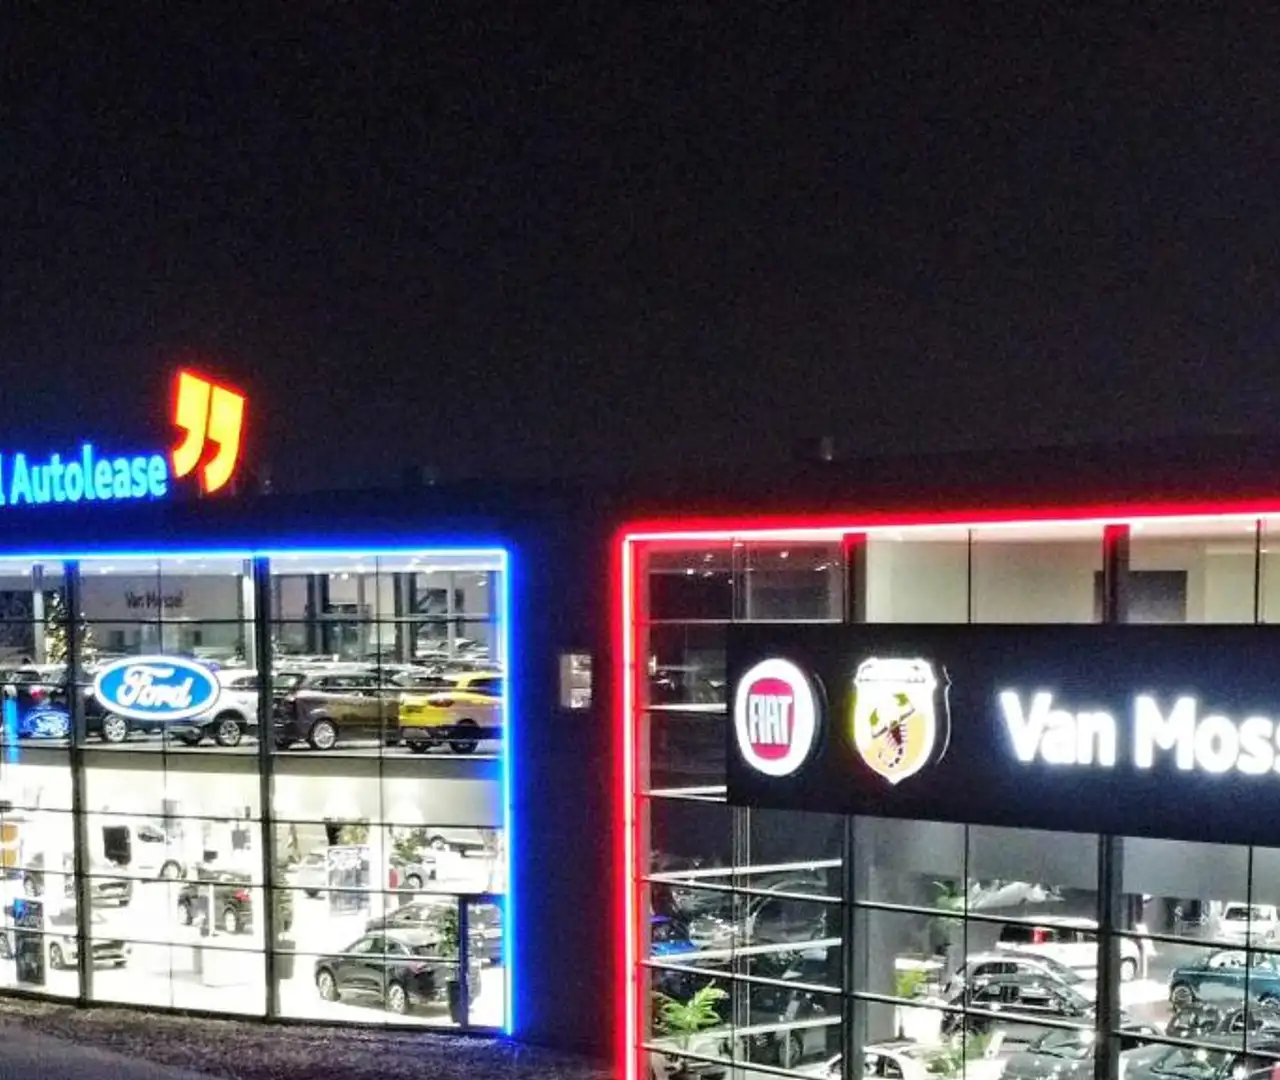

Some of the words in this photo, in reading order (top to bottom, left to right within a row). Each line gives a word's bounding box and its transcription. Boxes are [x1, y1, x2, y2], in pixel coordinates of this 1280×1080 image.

[9, 443, 168, 505] Autolease
[116, 664, 194, 709] Ford
[749, 692, 794, 745] FIAT
[998, 690, 1116, 767] Van
